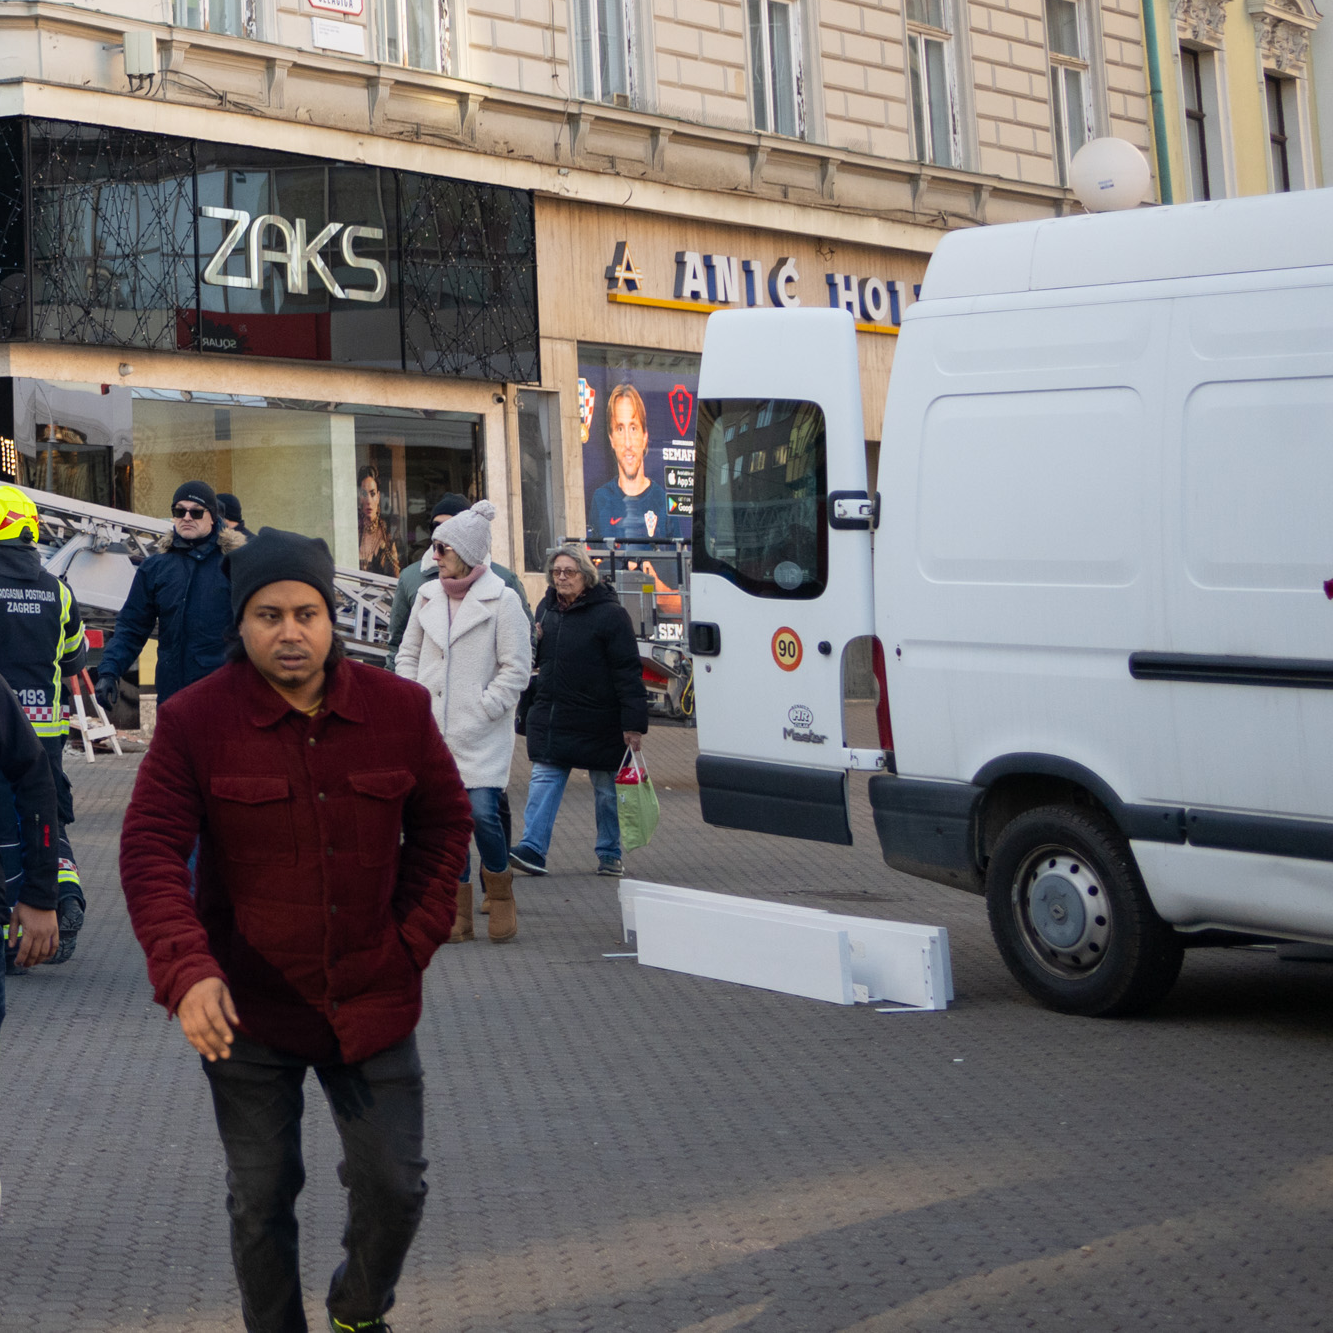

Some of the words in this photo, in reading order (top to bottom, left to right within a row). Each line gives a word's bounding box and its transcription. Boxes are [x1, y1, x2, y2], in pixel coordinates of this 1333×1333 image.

[199, 206, 387, 303] ZAKS
[673, 250, 801, 308] ANIĆ
[662, 447, 695, 462] SEMAF
[677, 476, 688, 487] App
[25, 590, 55, 602] POSTROJBA
[7, 602, 41, 614] ZAGREB
[778, 639, 796, 658] 90
[783, 727, 828, 744] Master
